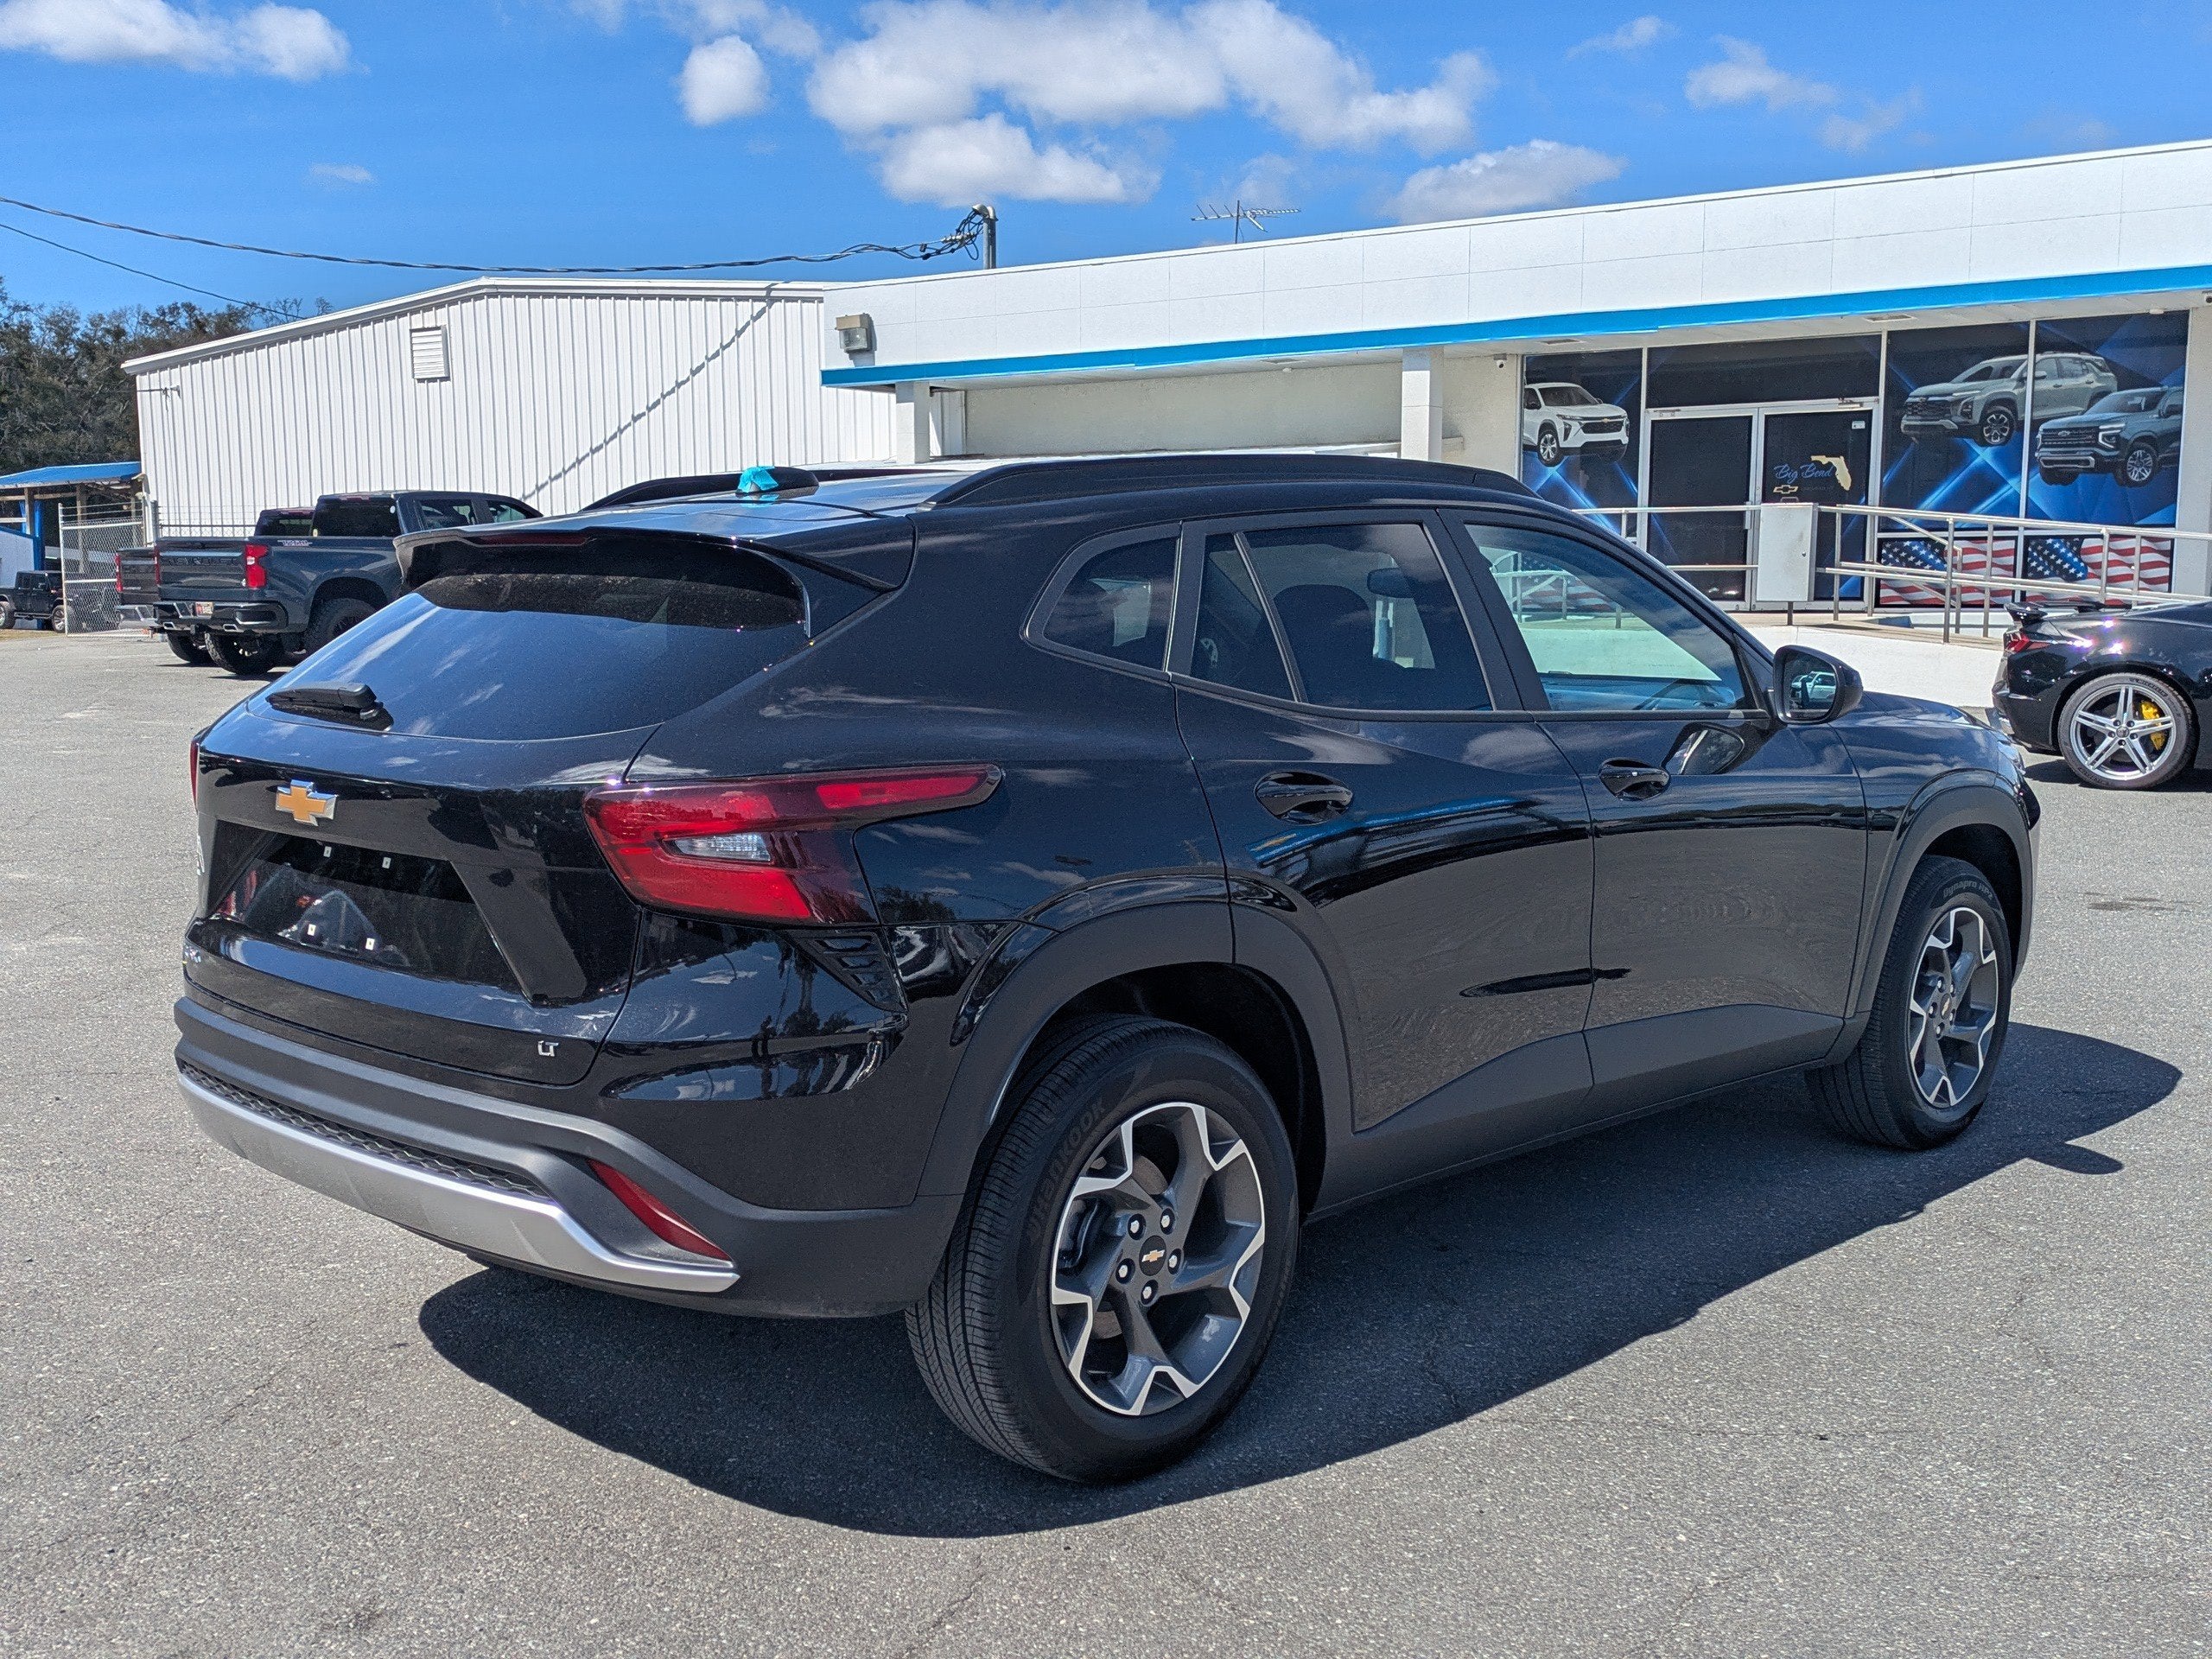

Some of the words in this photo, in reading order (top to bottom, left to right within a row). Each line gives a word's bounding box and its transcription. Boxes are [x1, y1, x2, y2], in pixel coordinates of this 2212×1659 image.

[1774, 464, 1798, 484] Big
[1800, 463, 1834, 479] Bend
[1943, 880, 1977, 898] Dynapro
[537, 1039, 560, 1058] LT
